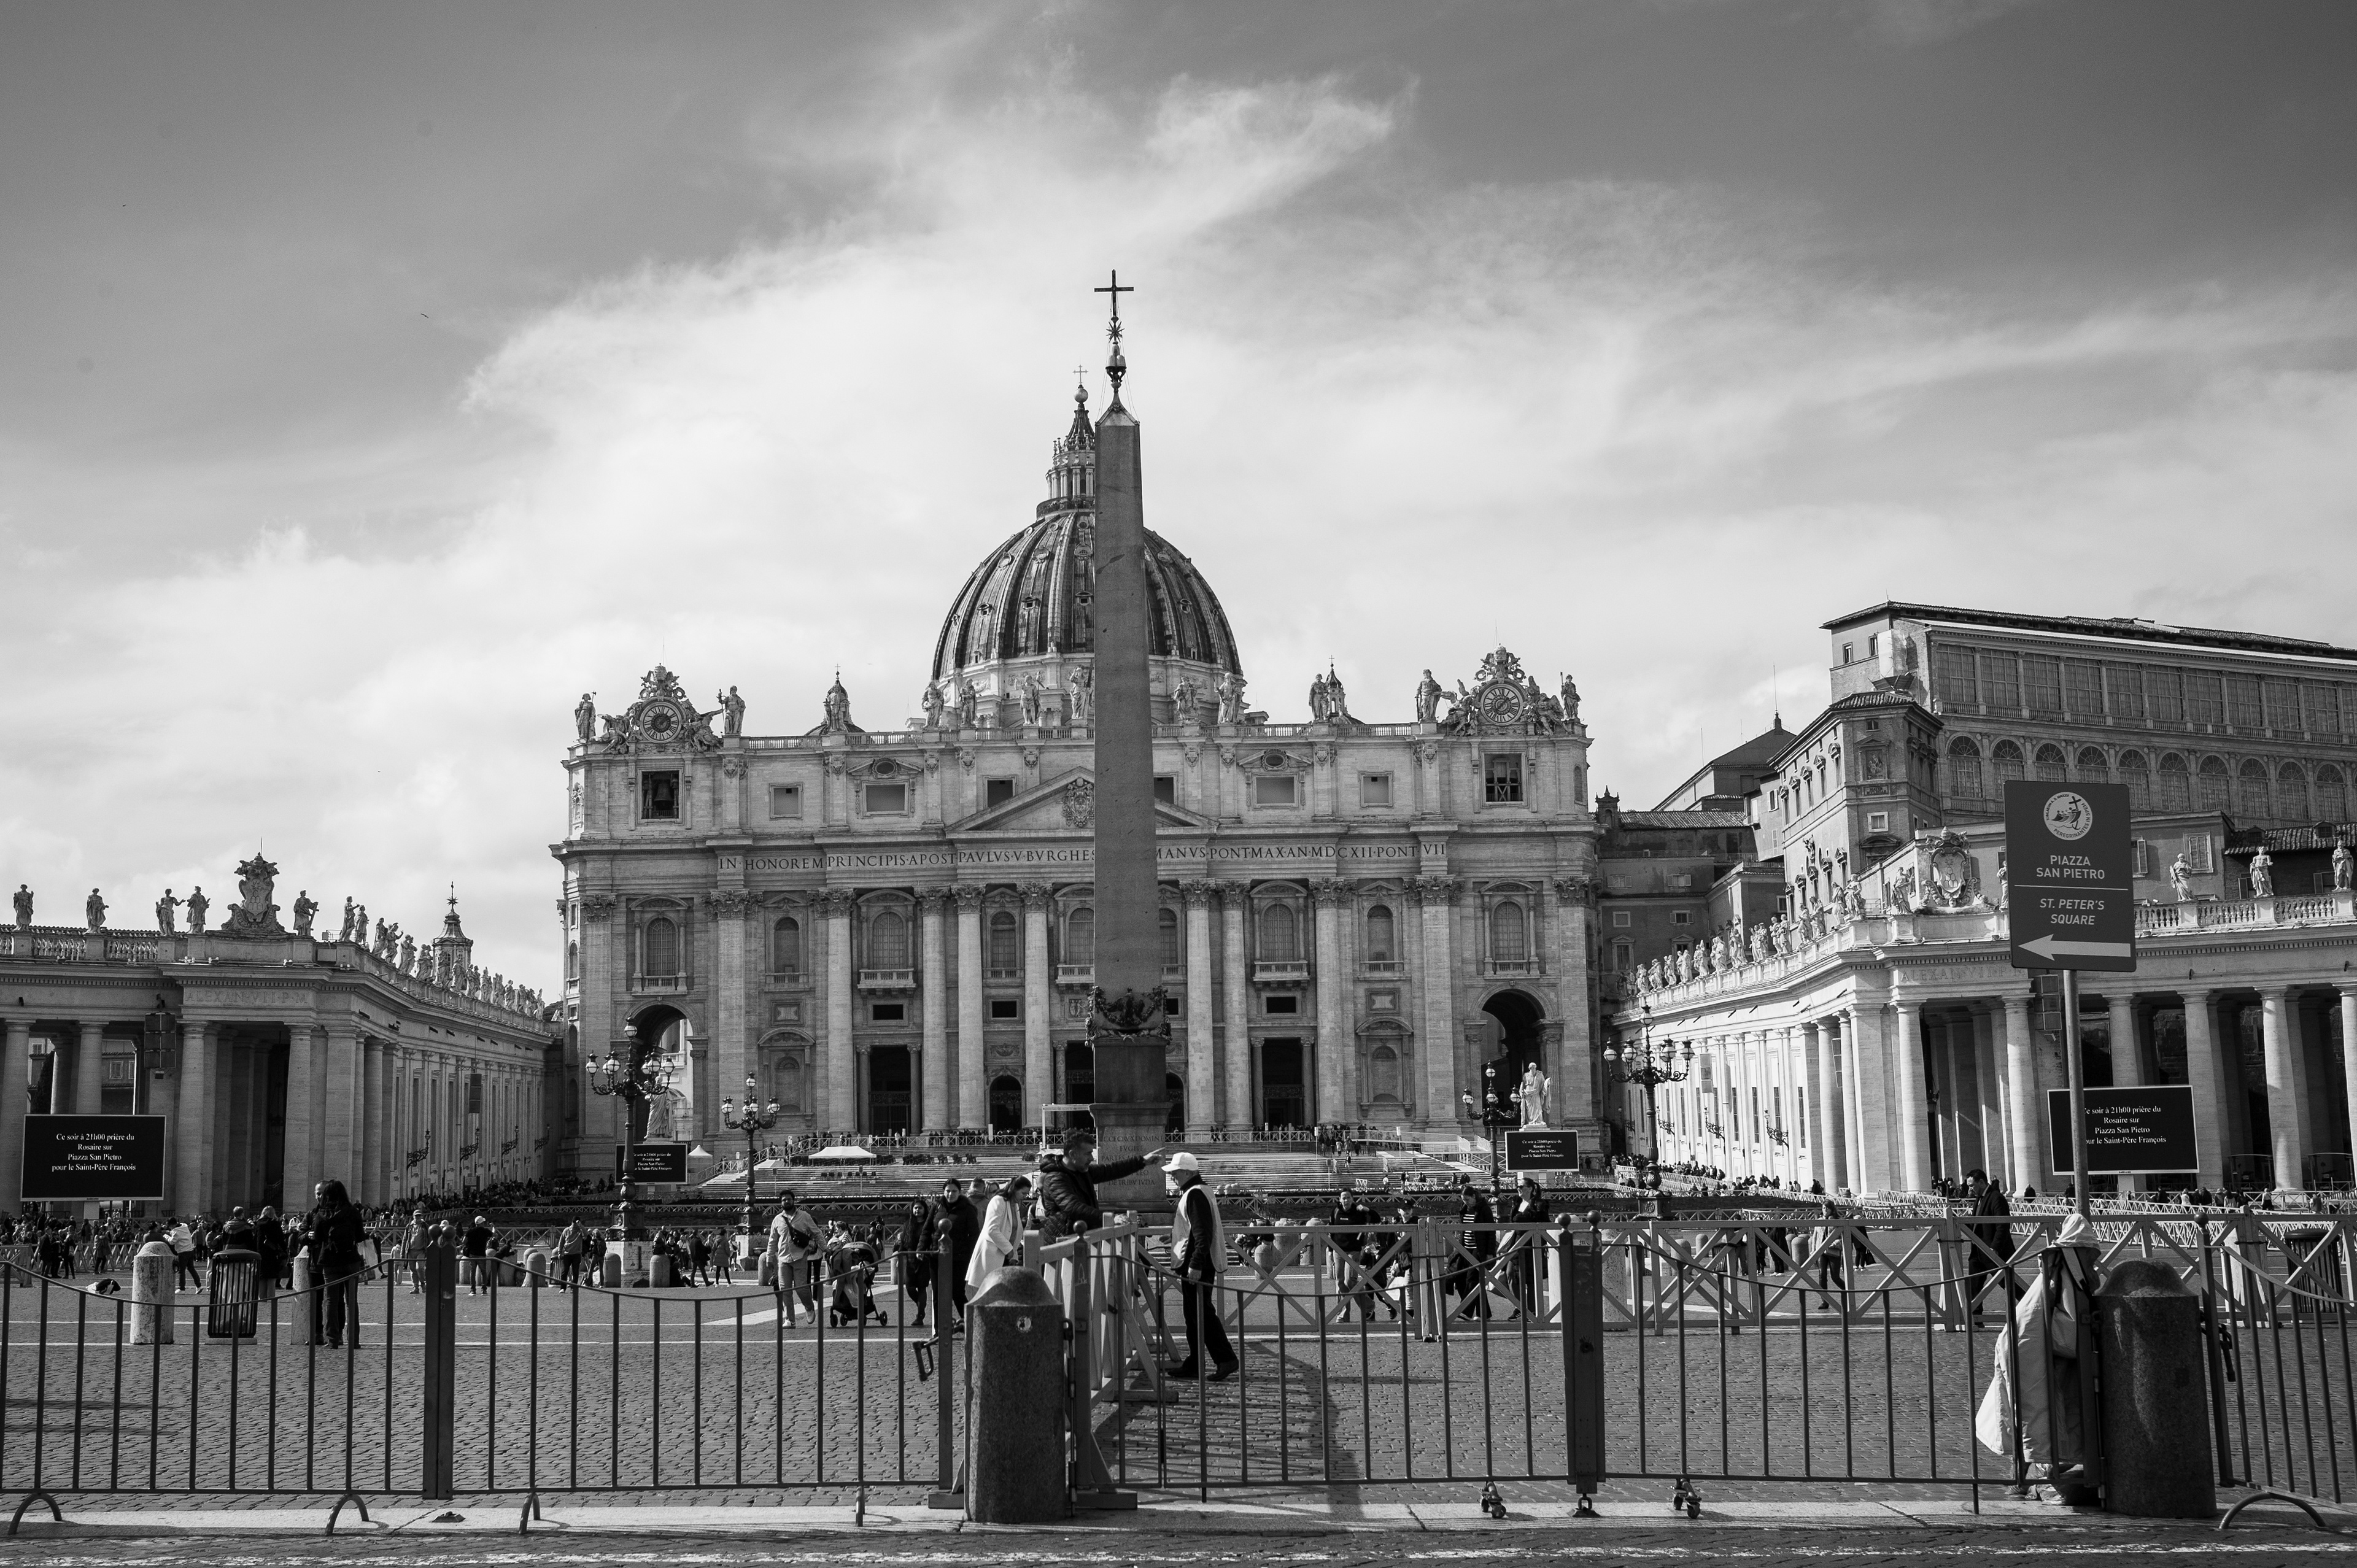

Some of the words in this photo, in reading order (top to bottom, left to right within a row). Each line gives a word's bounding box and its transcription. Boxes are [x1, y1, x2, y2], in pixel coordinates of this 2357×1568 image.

[2053, 823, 2089, 838] PEREGRINANTES
[2081, 802, 2091, 816] SPEM
[1210, 847, 1249, 859] PONT
[1251, 847, 1285, 858] MAX
[1287, 846, 1307, 858] AN
[1311, 846, 1372, 858] MDCXII
[1376, 846, 1417, 858] PONT
[1423, 844, 1445, 855] VII
[719, 858, 736, 869] IN
[745, 857, 824, 870] HONOREM
[828, 854, 905, 867] PRINCIPIS
[909, 853, 956, 865] APOST
[959, 851, 1010, 862] PAVLVS
[1013, 851, 1022, 862] V
[2050, 855, 2091, 866] PIAZZA
[2036, 867, 2060, 878] SAN
[2064, 868, 2105, 879] PIETRO
[2040, 898, 2055, 909] ST.
[2059, 899, 2105, 910] PETER'S
[2050, 914, 2095, 925] SQUARE
[2132, 1106, 2151, 1115] prière
[2138, 1136, 2166, 1145] François
